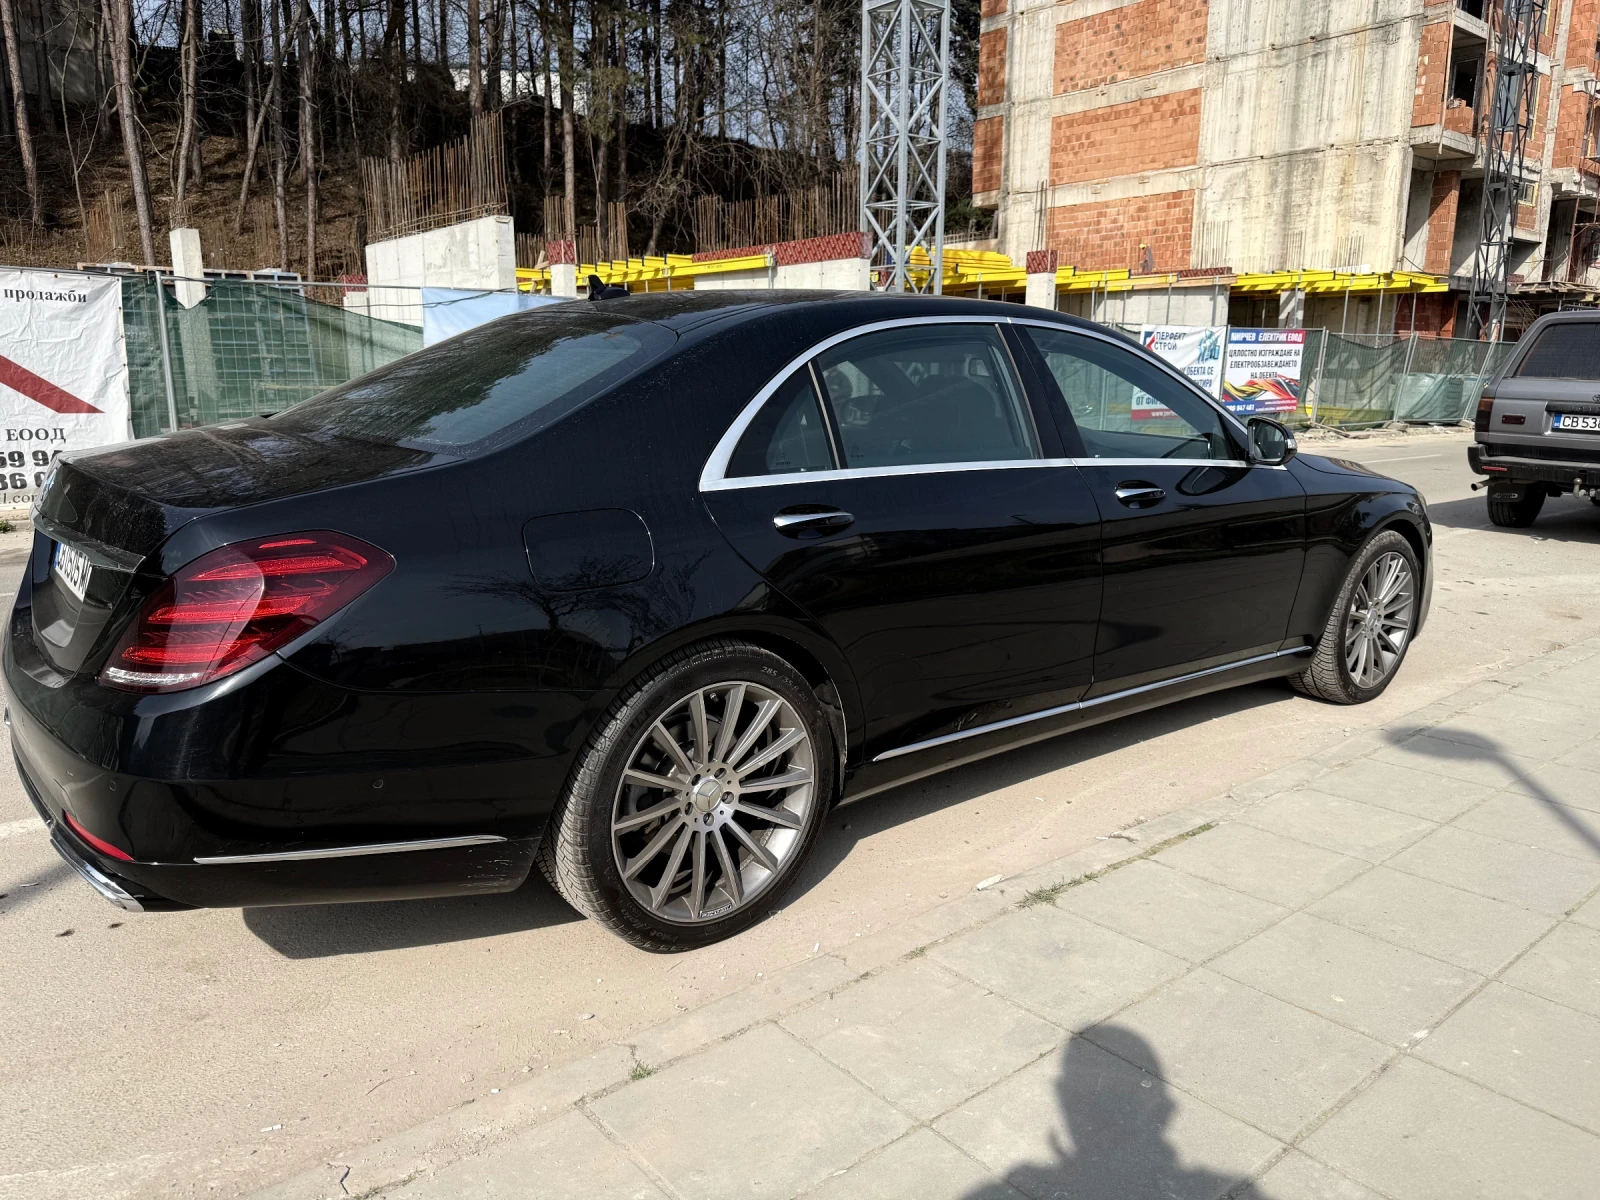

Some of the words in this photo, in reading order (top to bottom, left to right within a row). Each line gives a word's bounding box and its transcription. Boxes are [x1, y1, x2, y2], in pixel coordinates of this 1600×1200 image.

[4, 288, 87, 303] продажби
[1155, 331, 1187, 341] ПЕРФЕКТ
[1258, 332, 1288, 342] ЕЛЕКТРИК
[1288, 332, 1303, 343] ЕООД
[1154, 341, 1177, 351] СТРОЙ
[1228, 349, 1258, 358] ЦЯЛОСТНО
[1258, 349, 1293, 358] ИЗГРАЖДАНЕ
[1293, 349, 1300, 357] НА
[1229, 360, 1298, 369] ЕЛЕКТРООБЗАВЕЖДАНЕТО
[1186, 366, 1206, 376] ОБЕКТА
[1206, 366, 1214, 376] СЕ
[1250, 371, 1258, 380] НА
[1258, 371, 1278, 380] ОБЕКТА
[1135, 396, 1144, 406] ОТ
[1563, 416, 1579, 428] CB
[1581, 417, 1600, 429] 53
[6, 427, 66, 444] ЕООД
